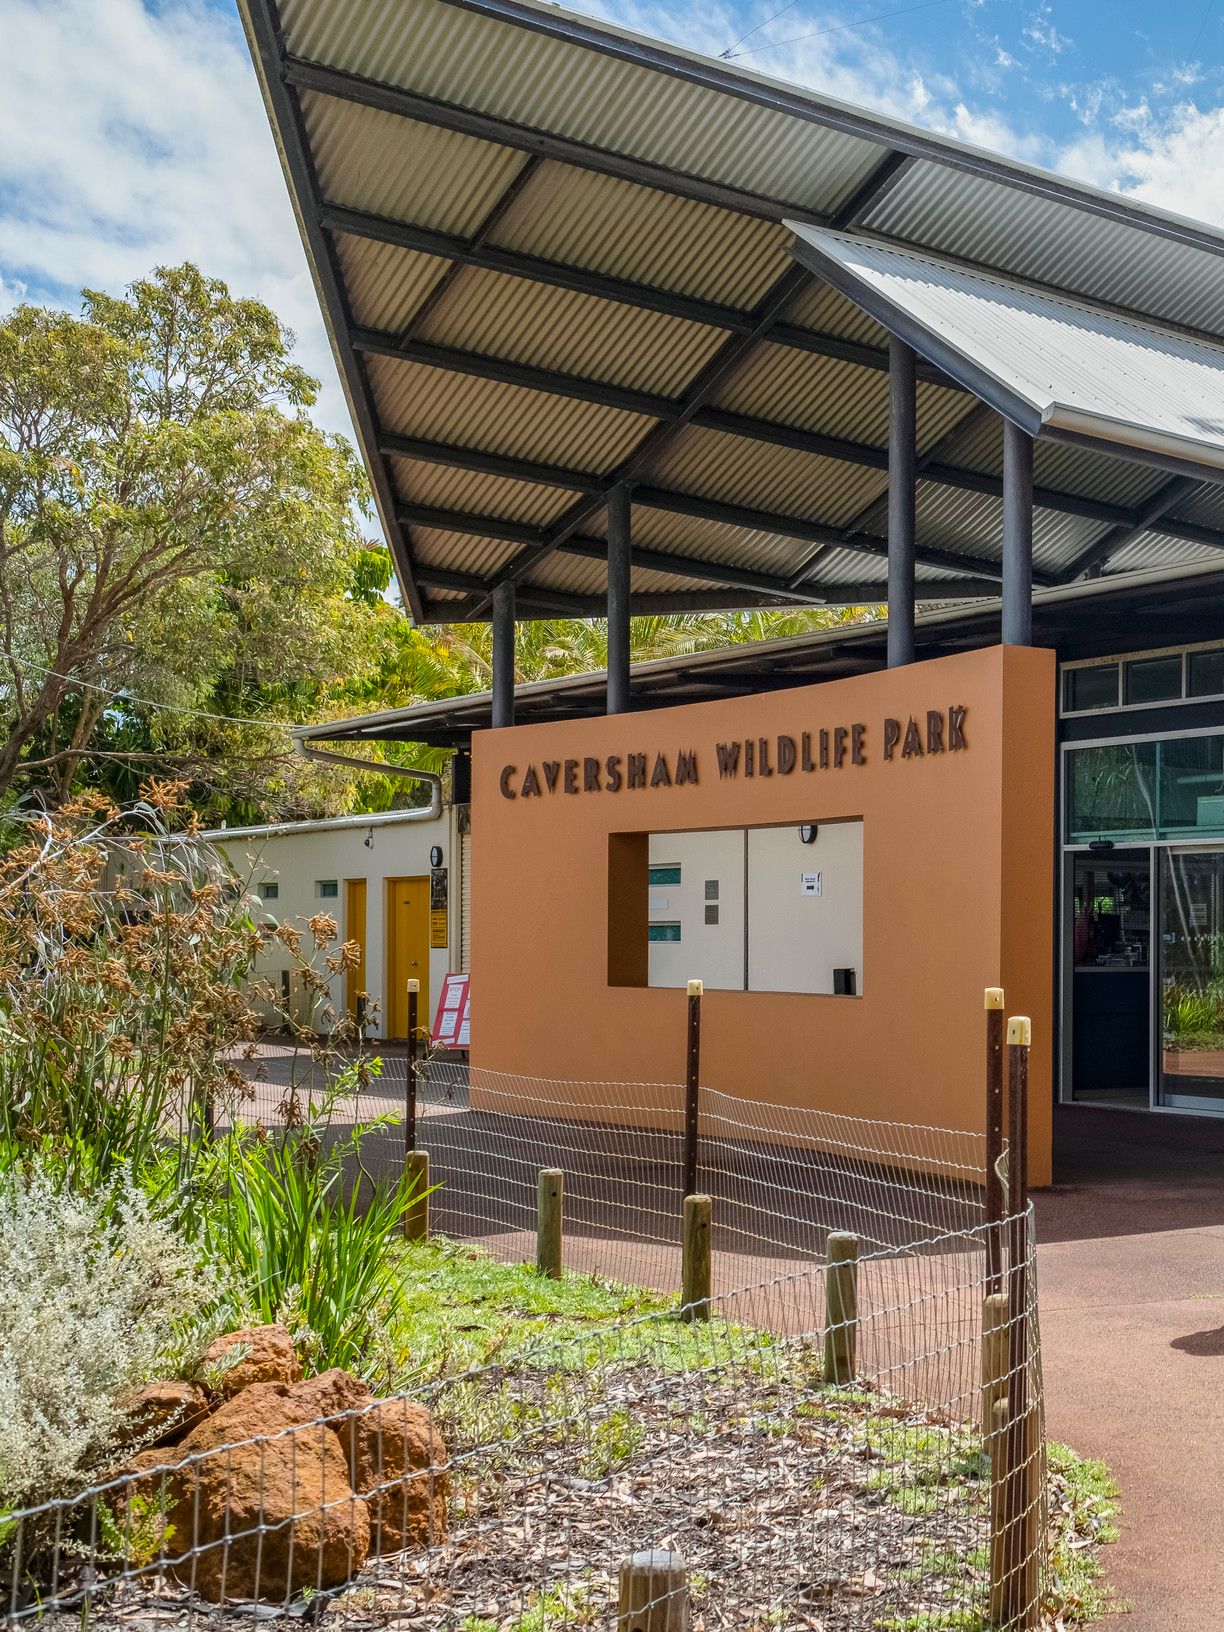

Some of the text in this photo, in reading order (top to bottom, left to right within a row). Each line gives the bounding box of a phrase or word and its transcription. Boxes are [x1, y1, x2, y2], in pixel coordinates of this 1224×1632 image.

[499, 704, 968, 800] CAVERSHAM WILDLIFE PARK
